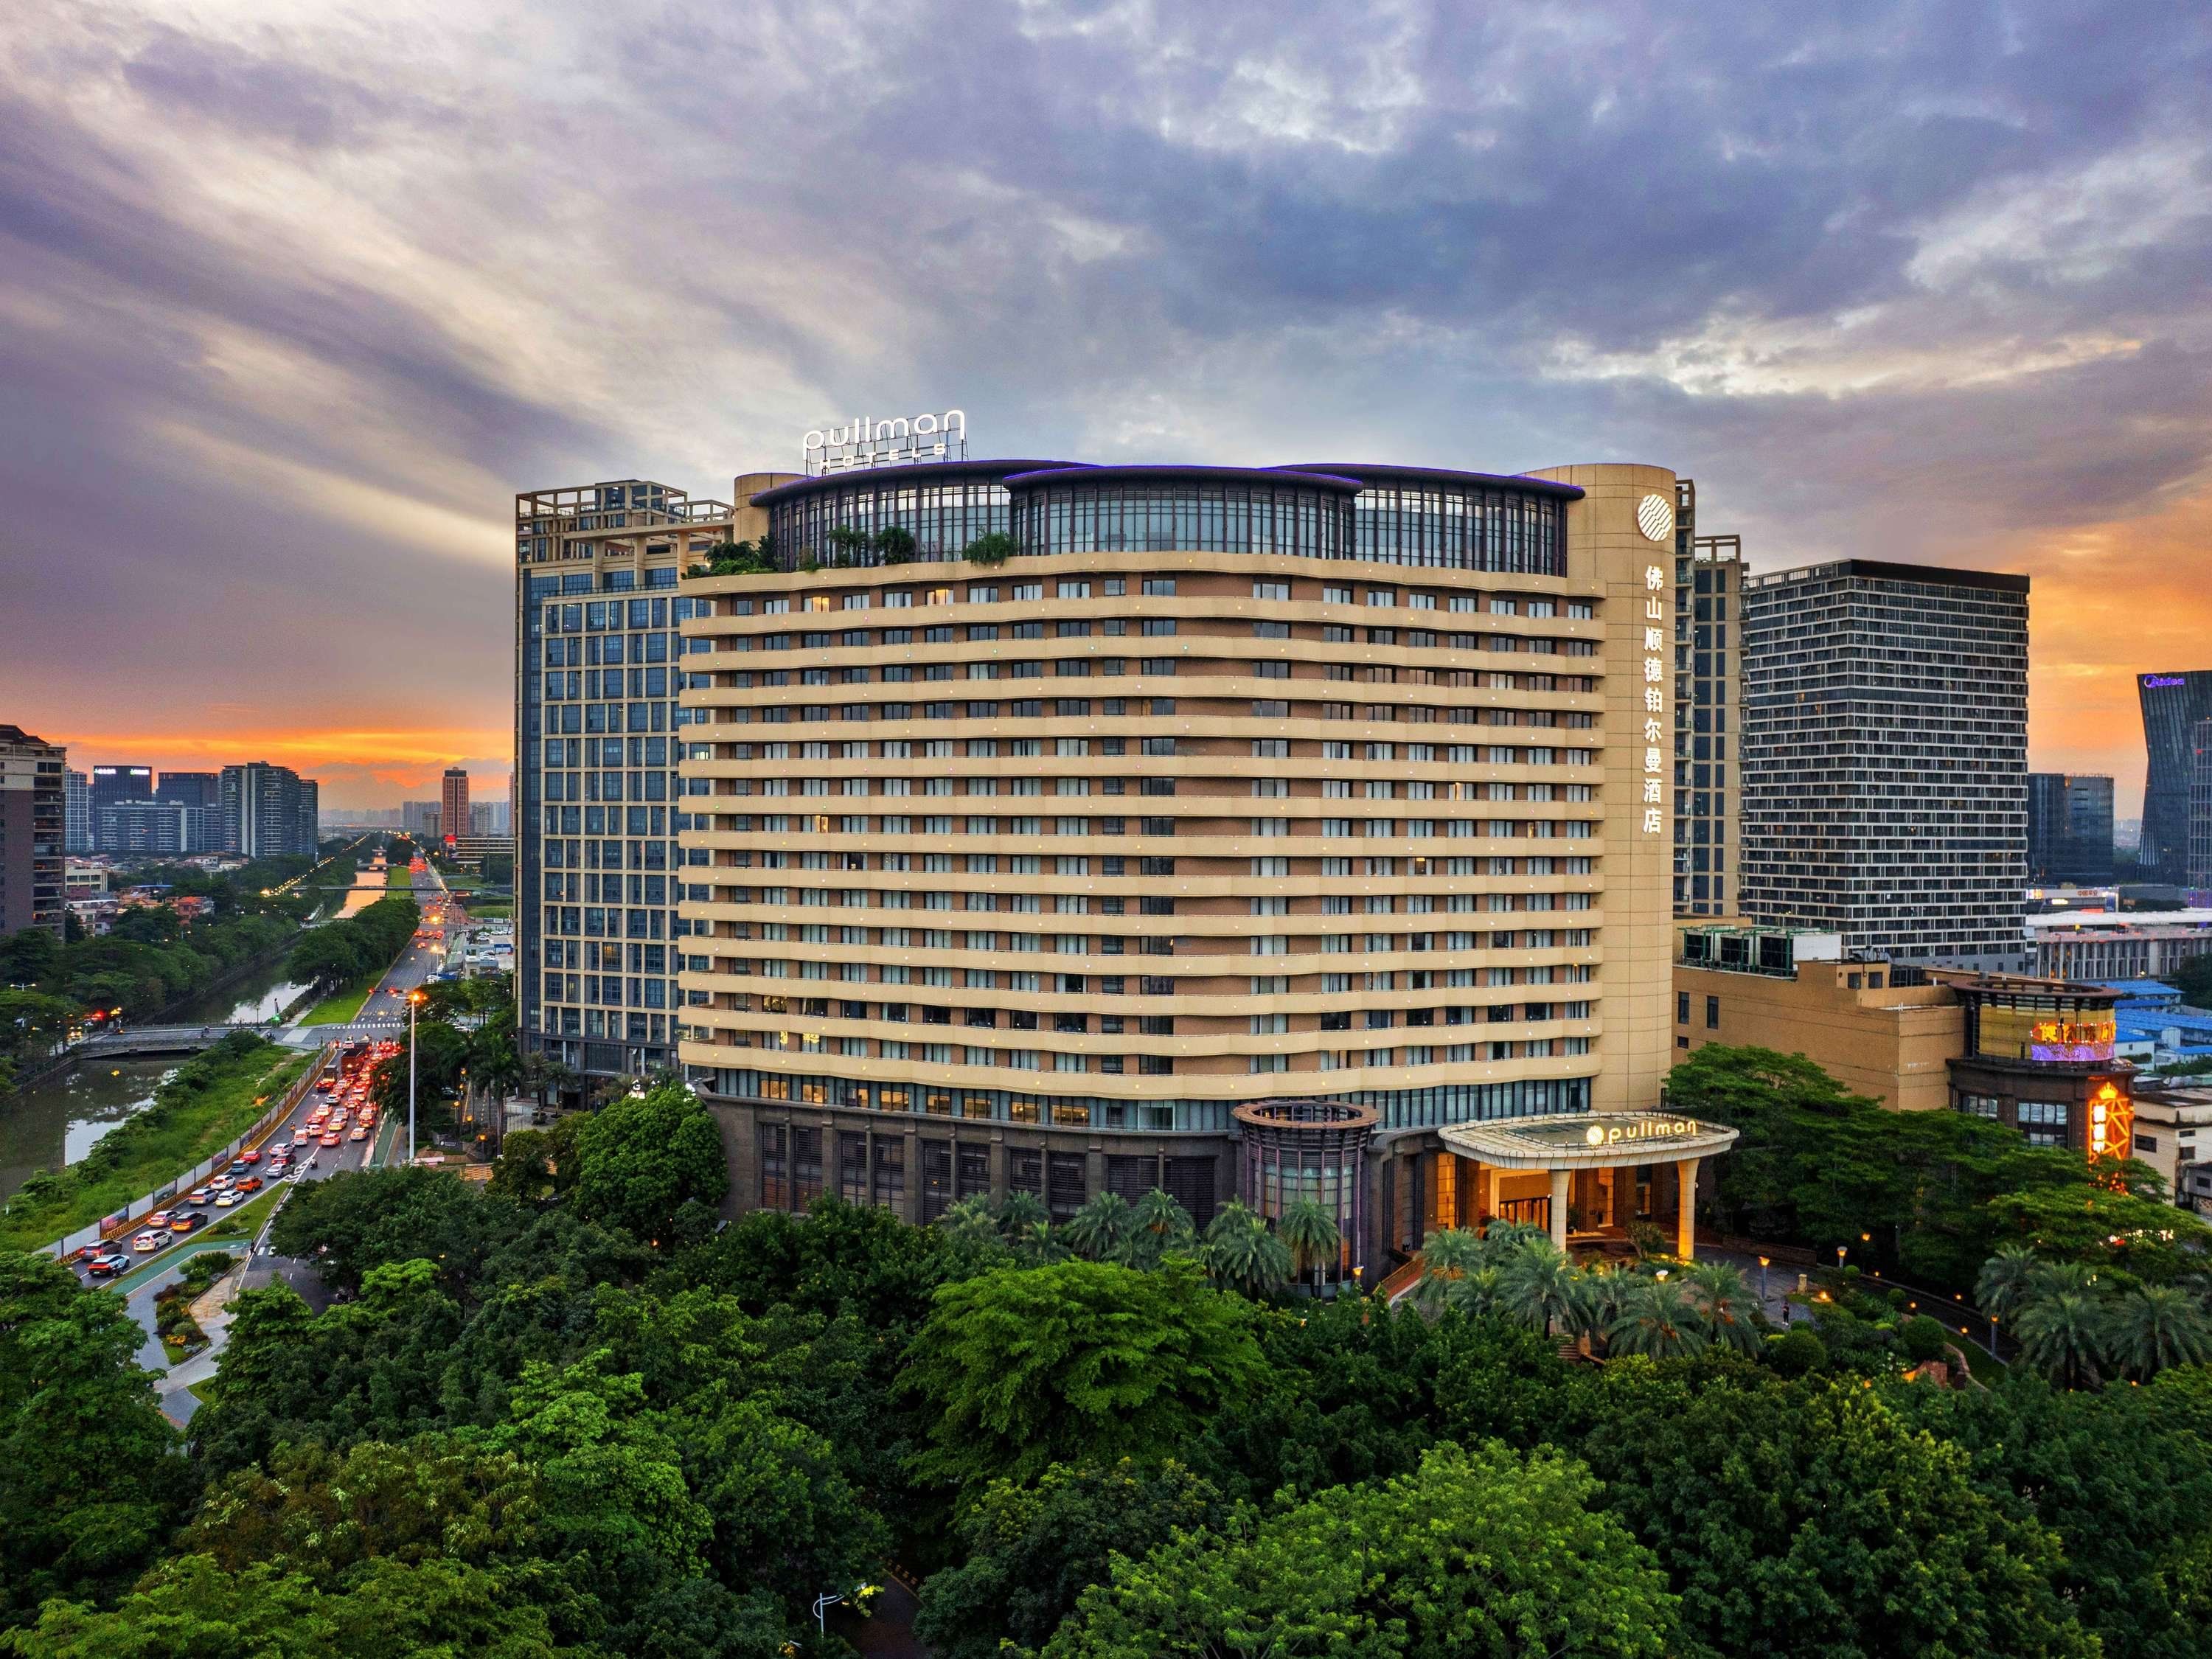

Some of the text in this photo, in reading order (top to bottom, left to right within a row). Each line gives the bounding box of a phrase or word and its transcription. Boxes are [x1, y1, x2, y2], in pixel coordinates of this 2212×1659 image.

[803, 410, 965, 461] pullman
[819, 443, 946, 470] HOTELS
[1643, 565, 1663, 834] 佛山顺德铂尔曼酒店
[1608, 1119, 1697, 1145] pullman
